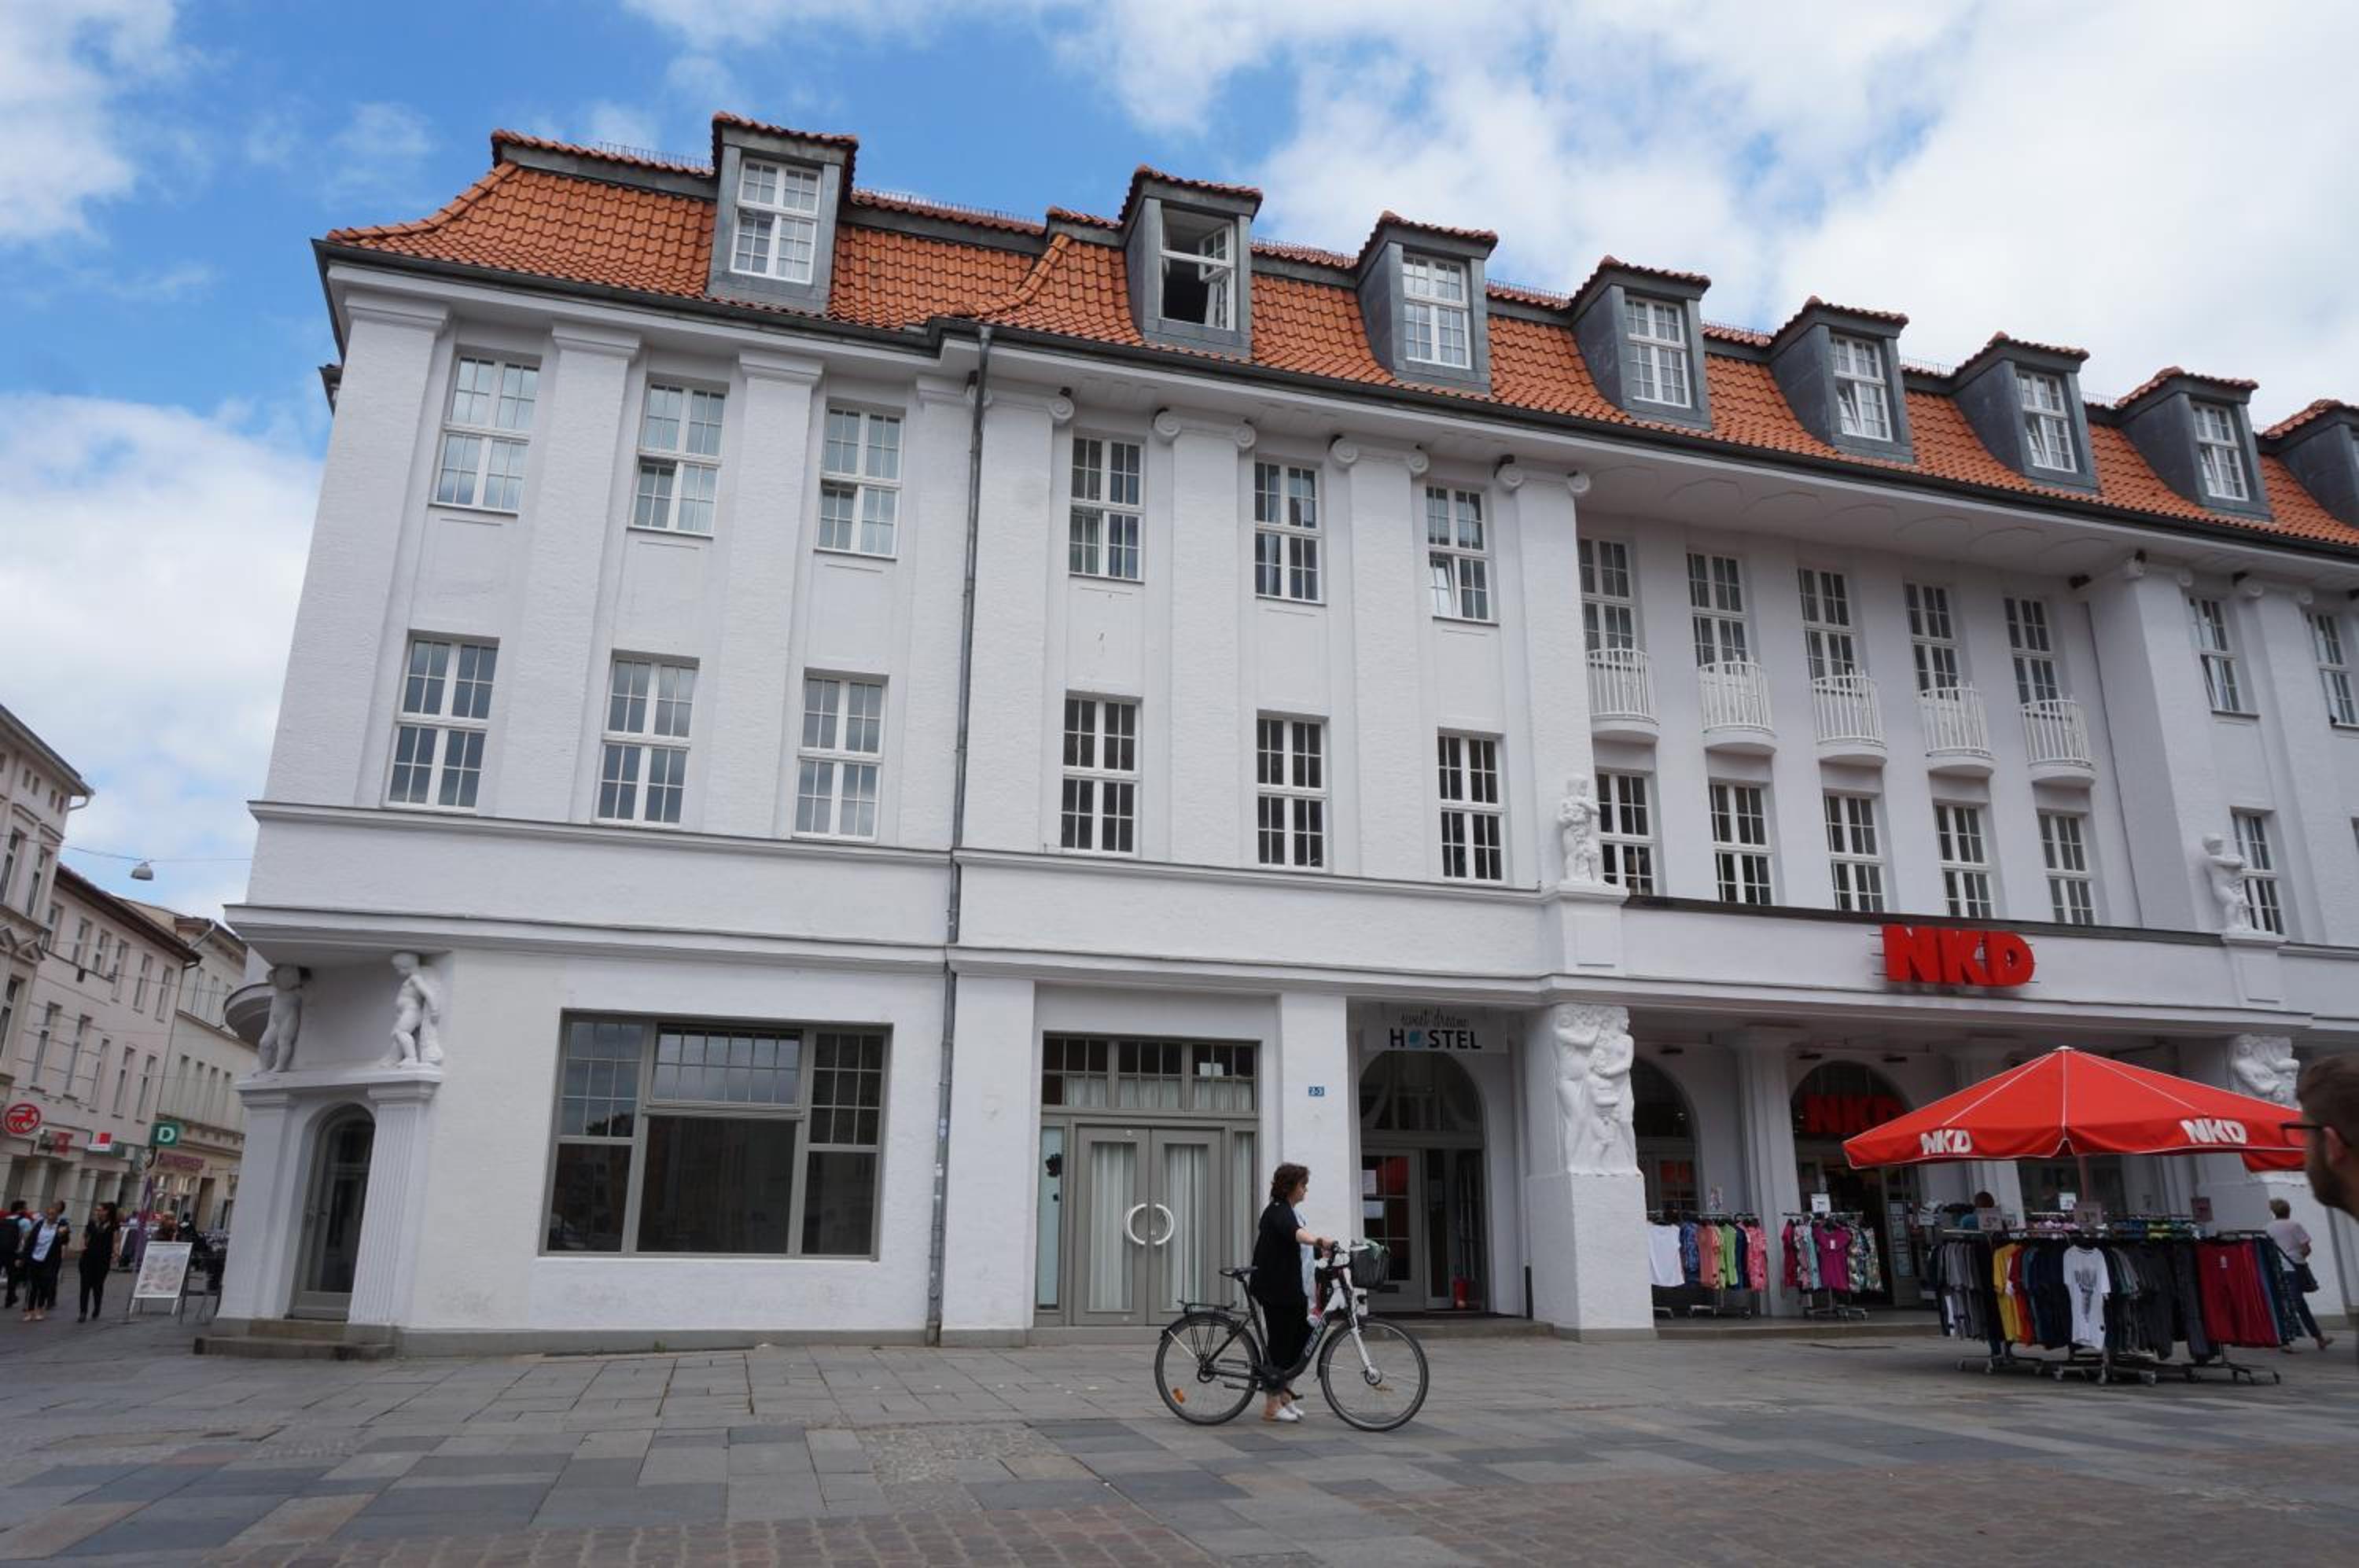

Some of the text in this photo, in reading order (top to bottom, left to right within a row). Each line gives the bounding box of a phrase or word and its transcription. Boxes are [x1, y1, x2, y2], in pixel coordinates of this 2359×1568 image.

[1882, 923, 2035, 988] NKD
[1920, 1129, 1972, 1155] NKD
[2179, 1118, 2247, 1144] NKD
